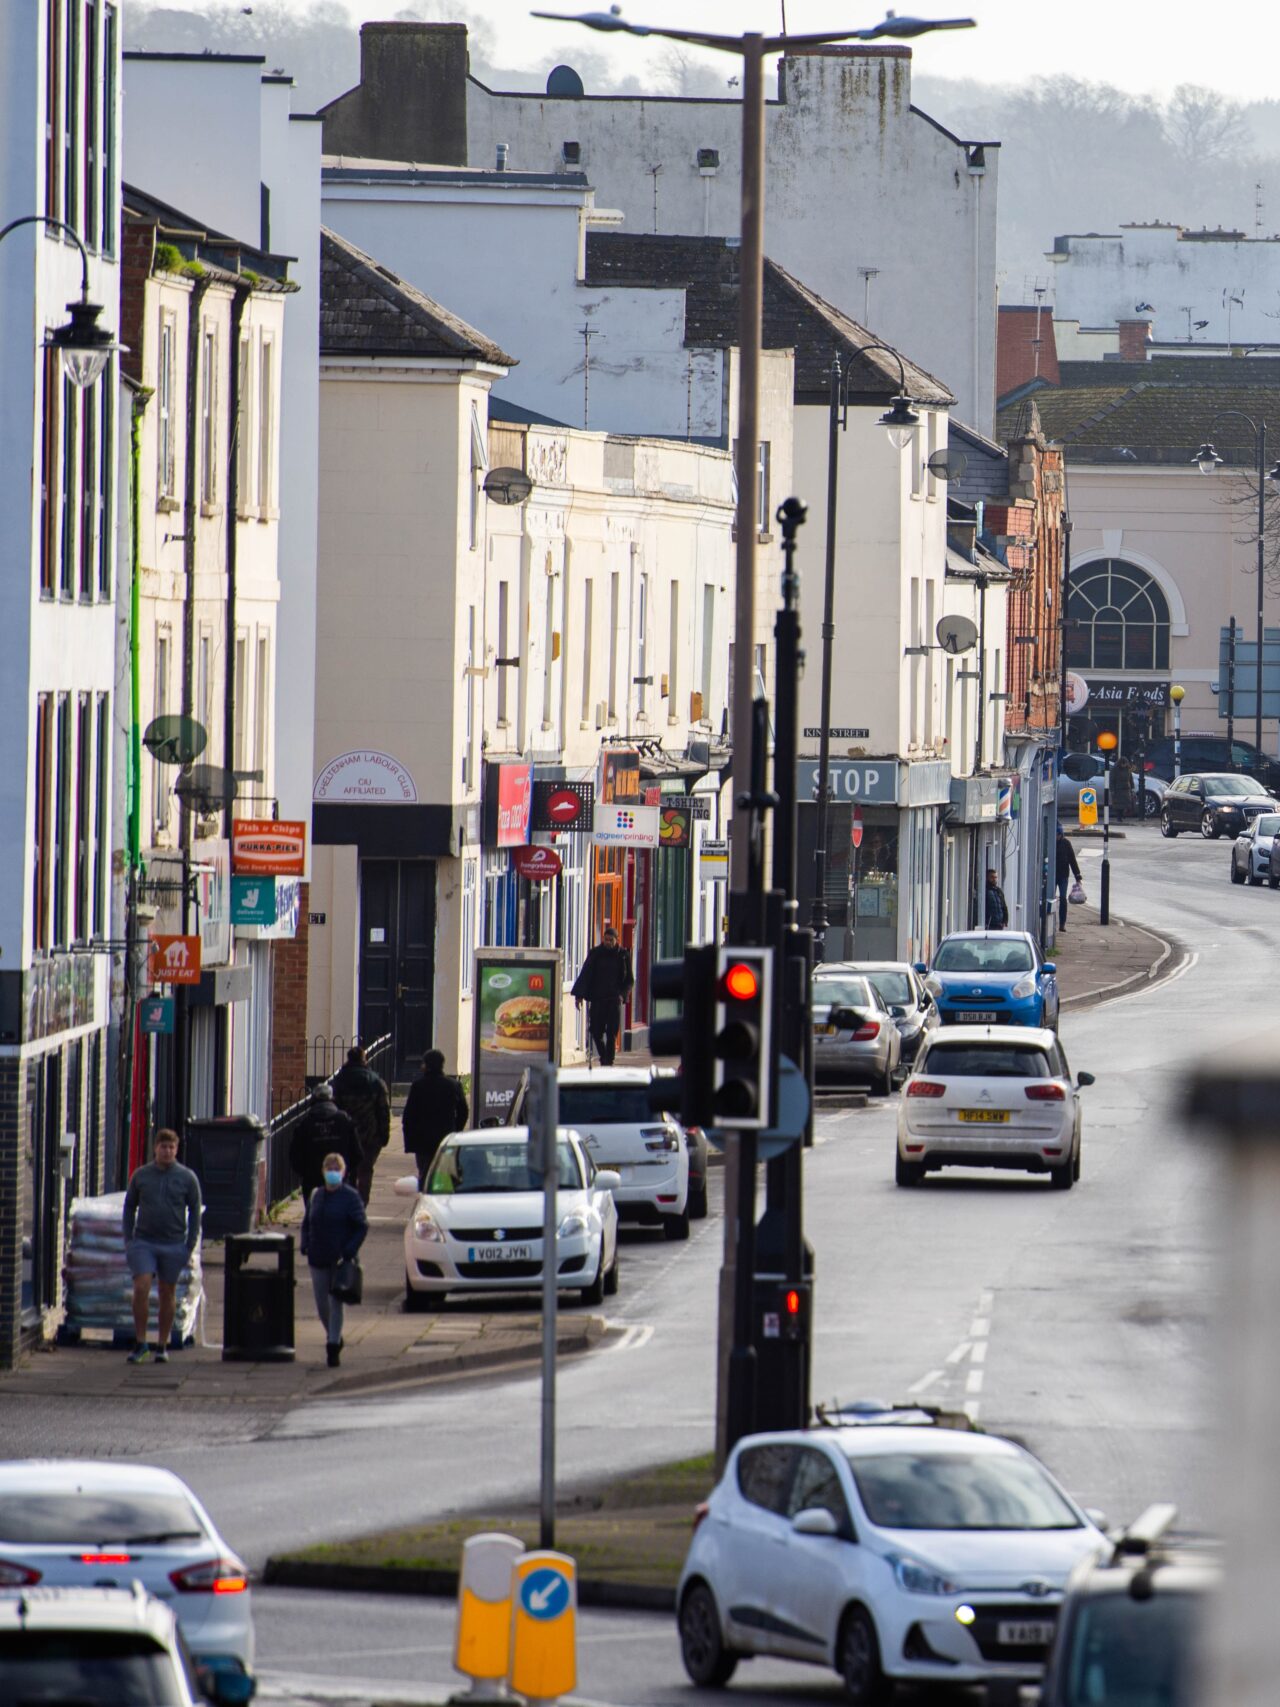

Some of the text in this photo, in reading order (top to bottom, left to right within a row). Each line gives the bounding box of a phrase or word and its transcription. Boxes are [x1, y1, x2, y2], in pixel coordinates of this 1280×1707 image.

[806, 729, 869, 738] KIN STREET
[318, 754, 411, 798] CHELTENHAM LABOUR CLUB
[343, 787, 387, 795] AFFILIATED
[666, 797, 705, 808] T-SHIRT
[237, 823, 260, 832] Fish
[271, 824, 301, 834] Chips
[595, 831, 654, 842] ajgreenprinting
[520, 861, 557, 871] hungryhouse
[156, 969, 195, 978] JUST EAT
[506, 1246, 527, 1258] JYN
